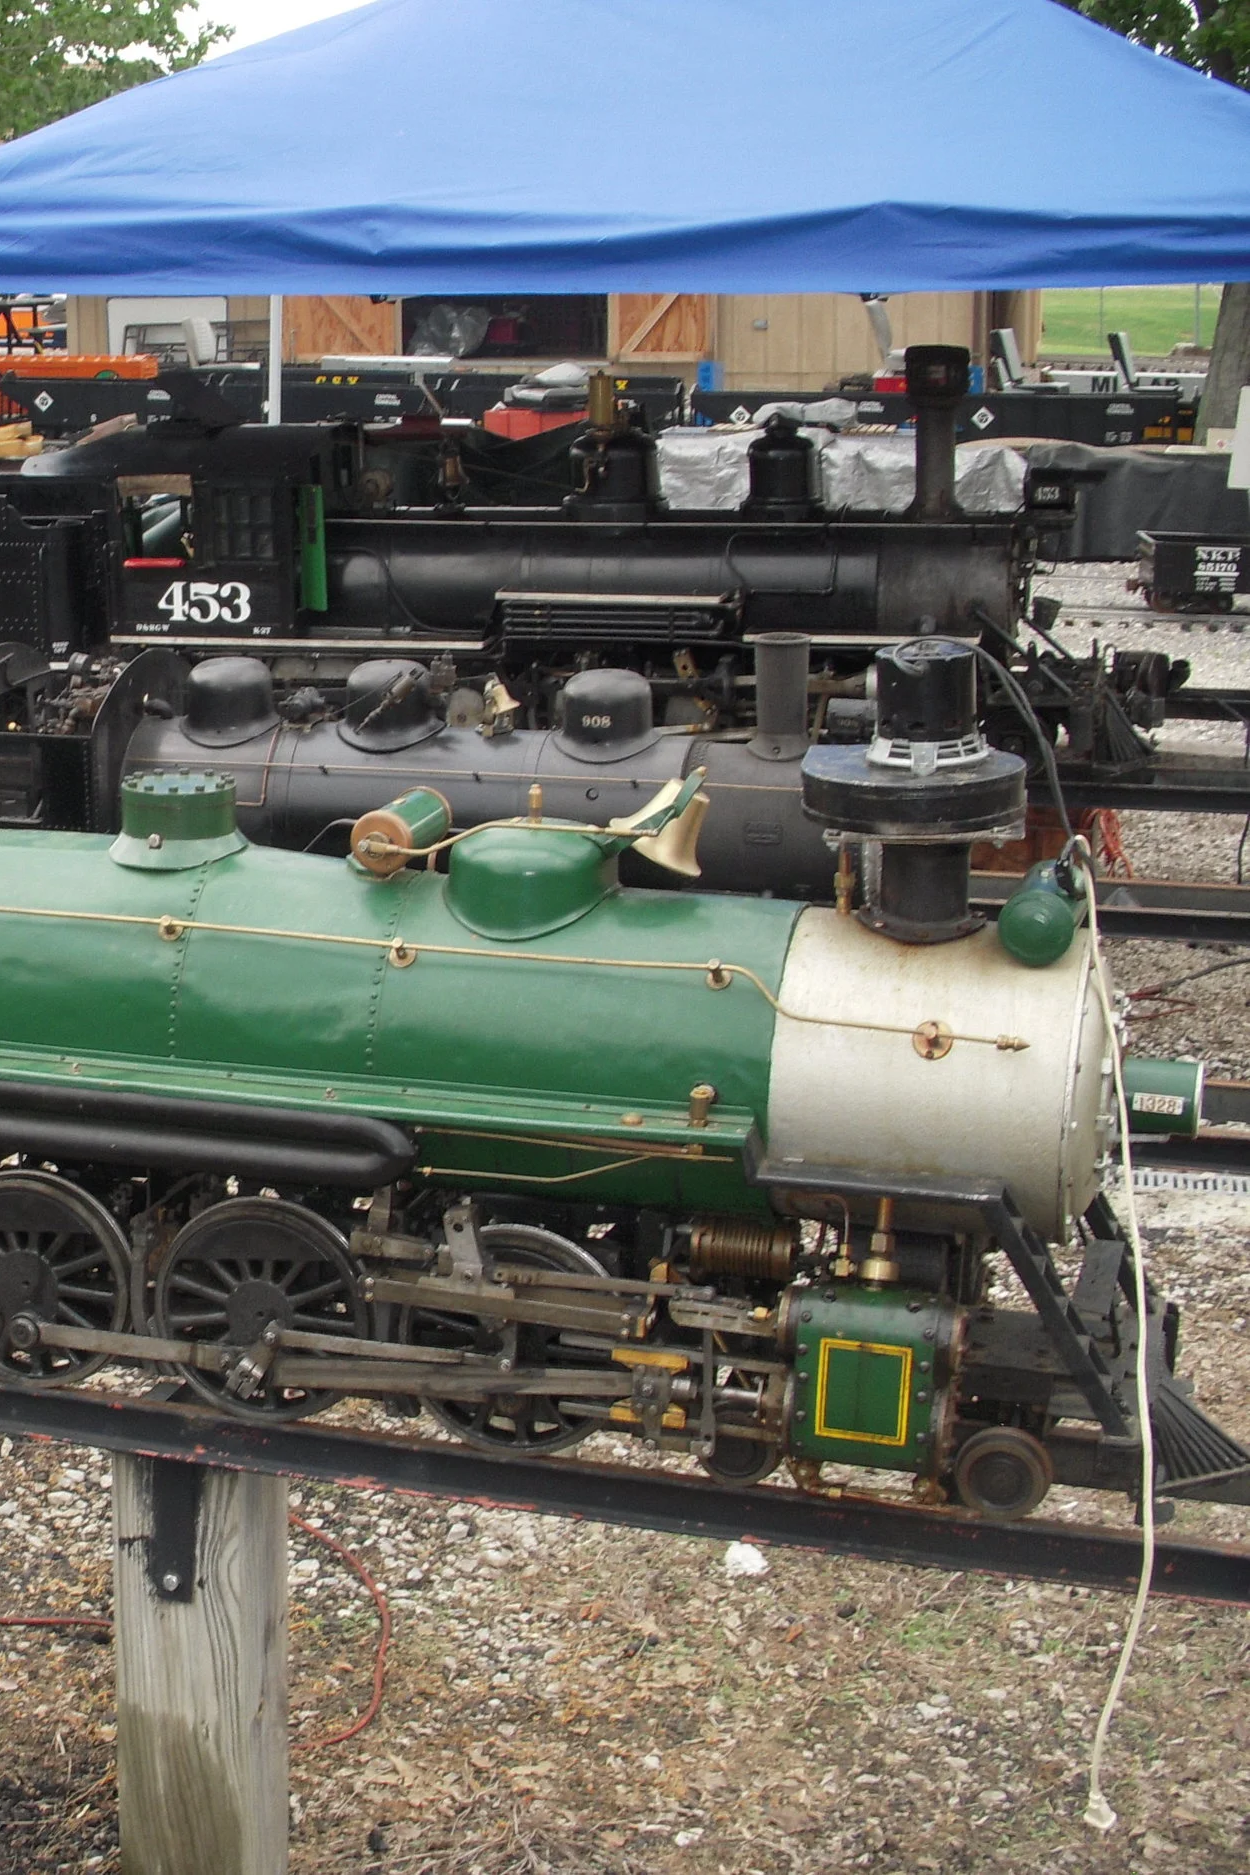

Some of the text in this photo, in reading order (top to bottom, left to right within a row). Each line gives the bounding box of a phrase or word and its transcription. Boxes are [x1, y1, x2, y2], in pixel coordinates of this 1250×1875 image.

[157, 581, 252, 623] 453
[582, 715, 612, 728] 908
[1138, 1096, 1178, 1114] 1328
